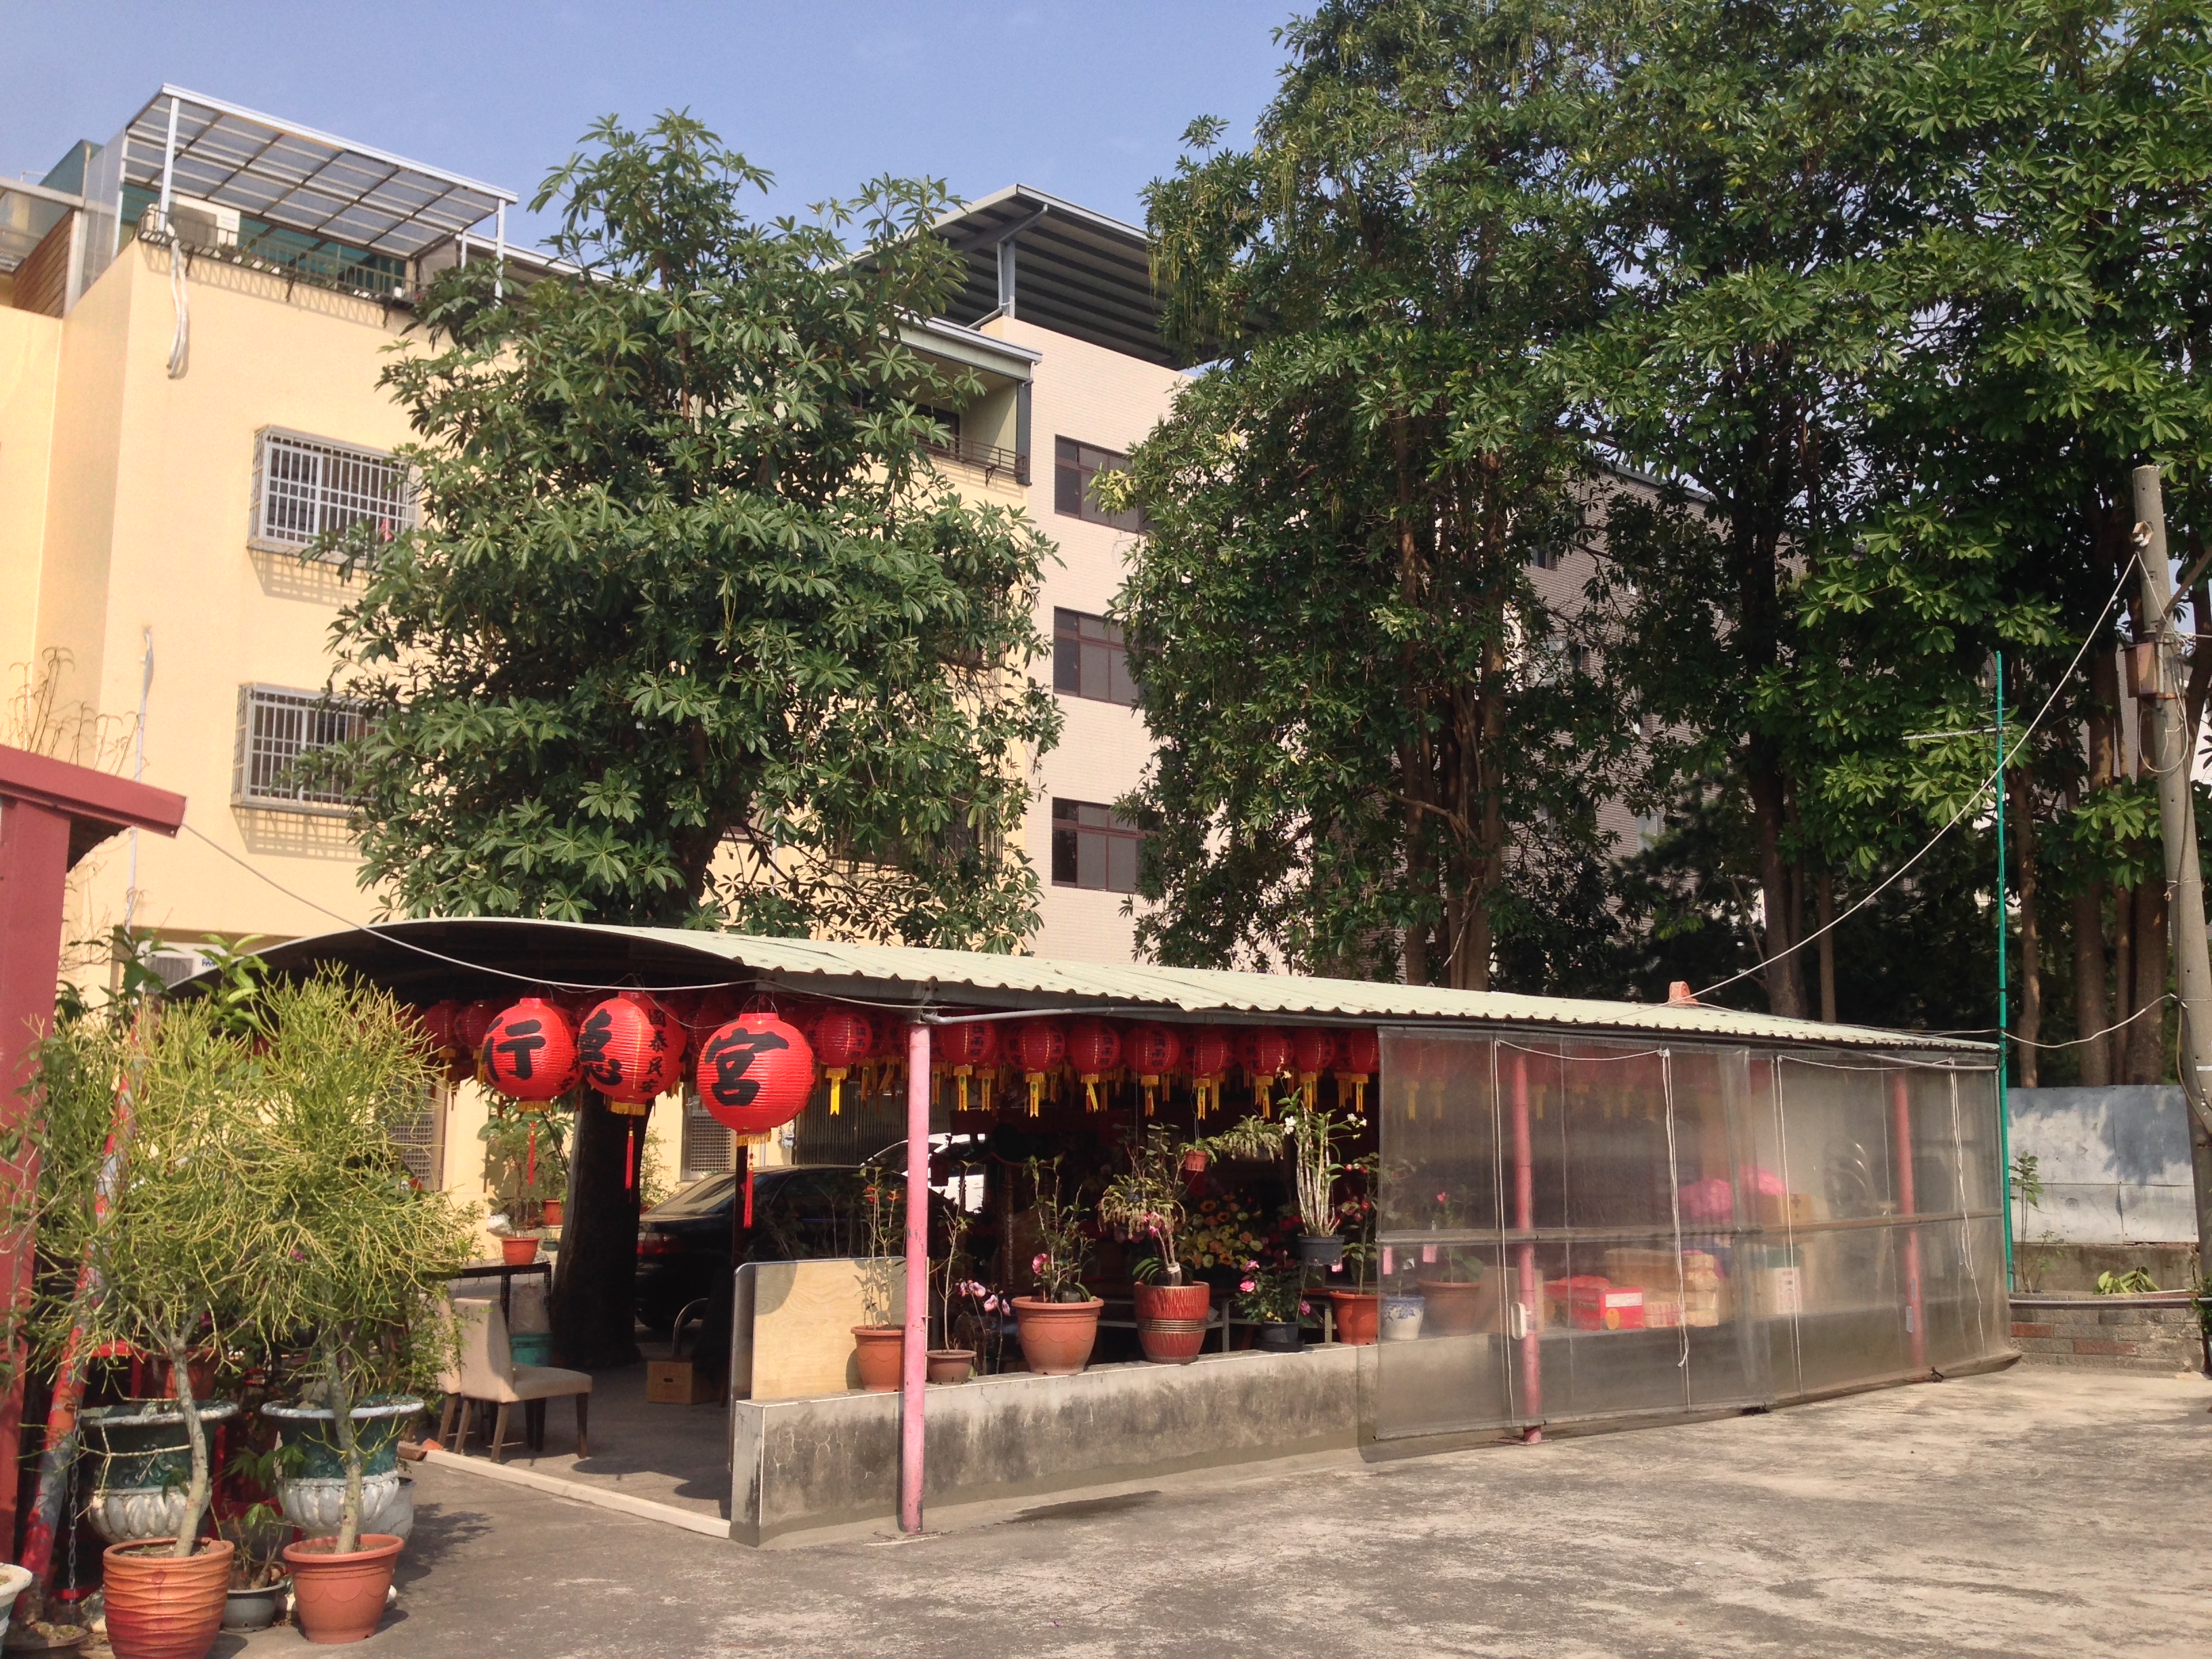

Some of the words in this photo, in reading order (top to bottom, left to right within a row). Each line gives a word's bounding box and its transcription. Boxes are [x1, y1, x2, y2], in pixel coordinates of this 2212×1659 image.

[483, 1017, 546, 1082] 行
[639, 1008, 669, 1093] 國泰民安
[704, 1027, 790, 1106] 宮
